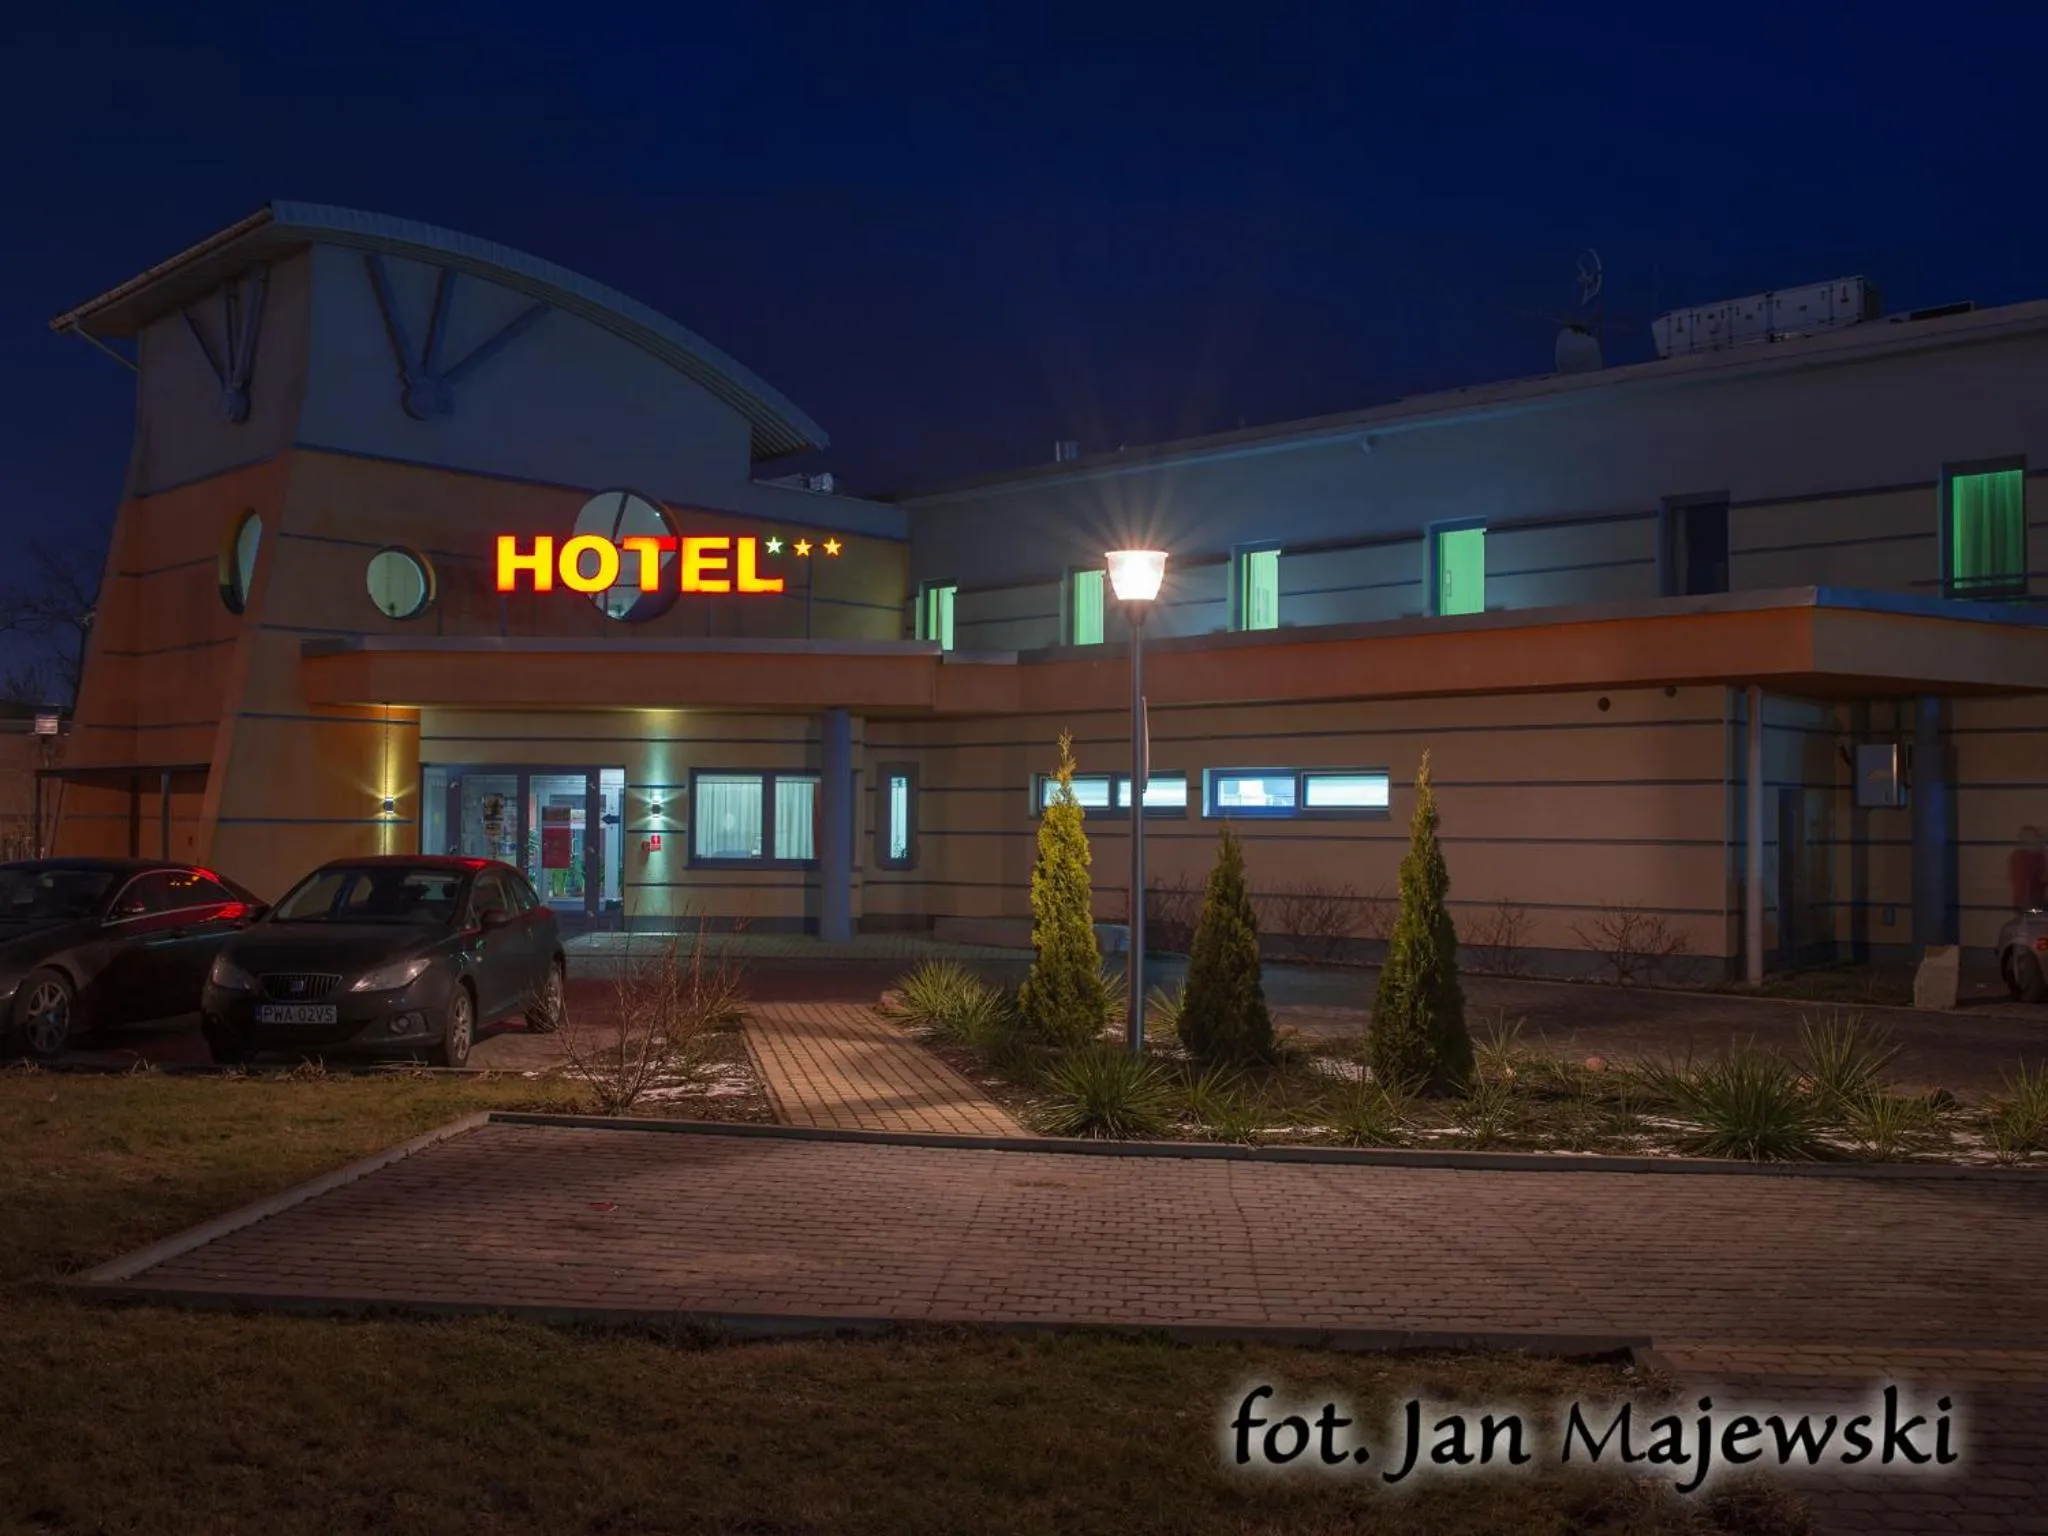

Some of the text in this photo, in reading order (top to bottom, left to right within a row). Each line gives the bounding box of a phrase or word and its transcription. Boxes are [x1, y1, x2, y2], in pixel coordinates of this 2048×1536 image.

[496, 534, 784, 593] HOTEL
[264, 1007, 333, 1022] PWA 02VS
